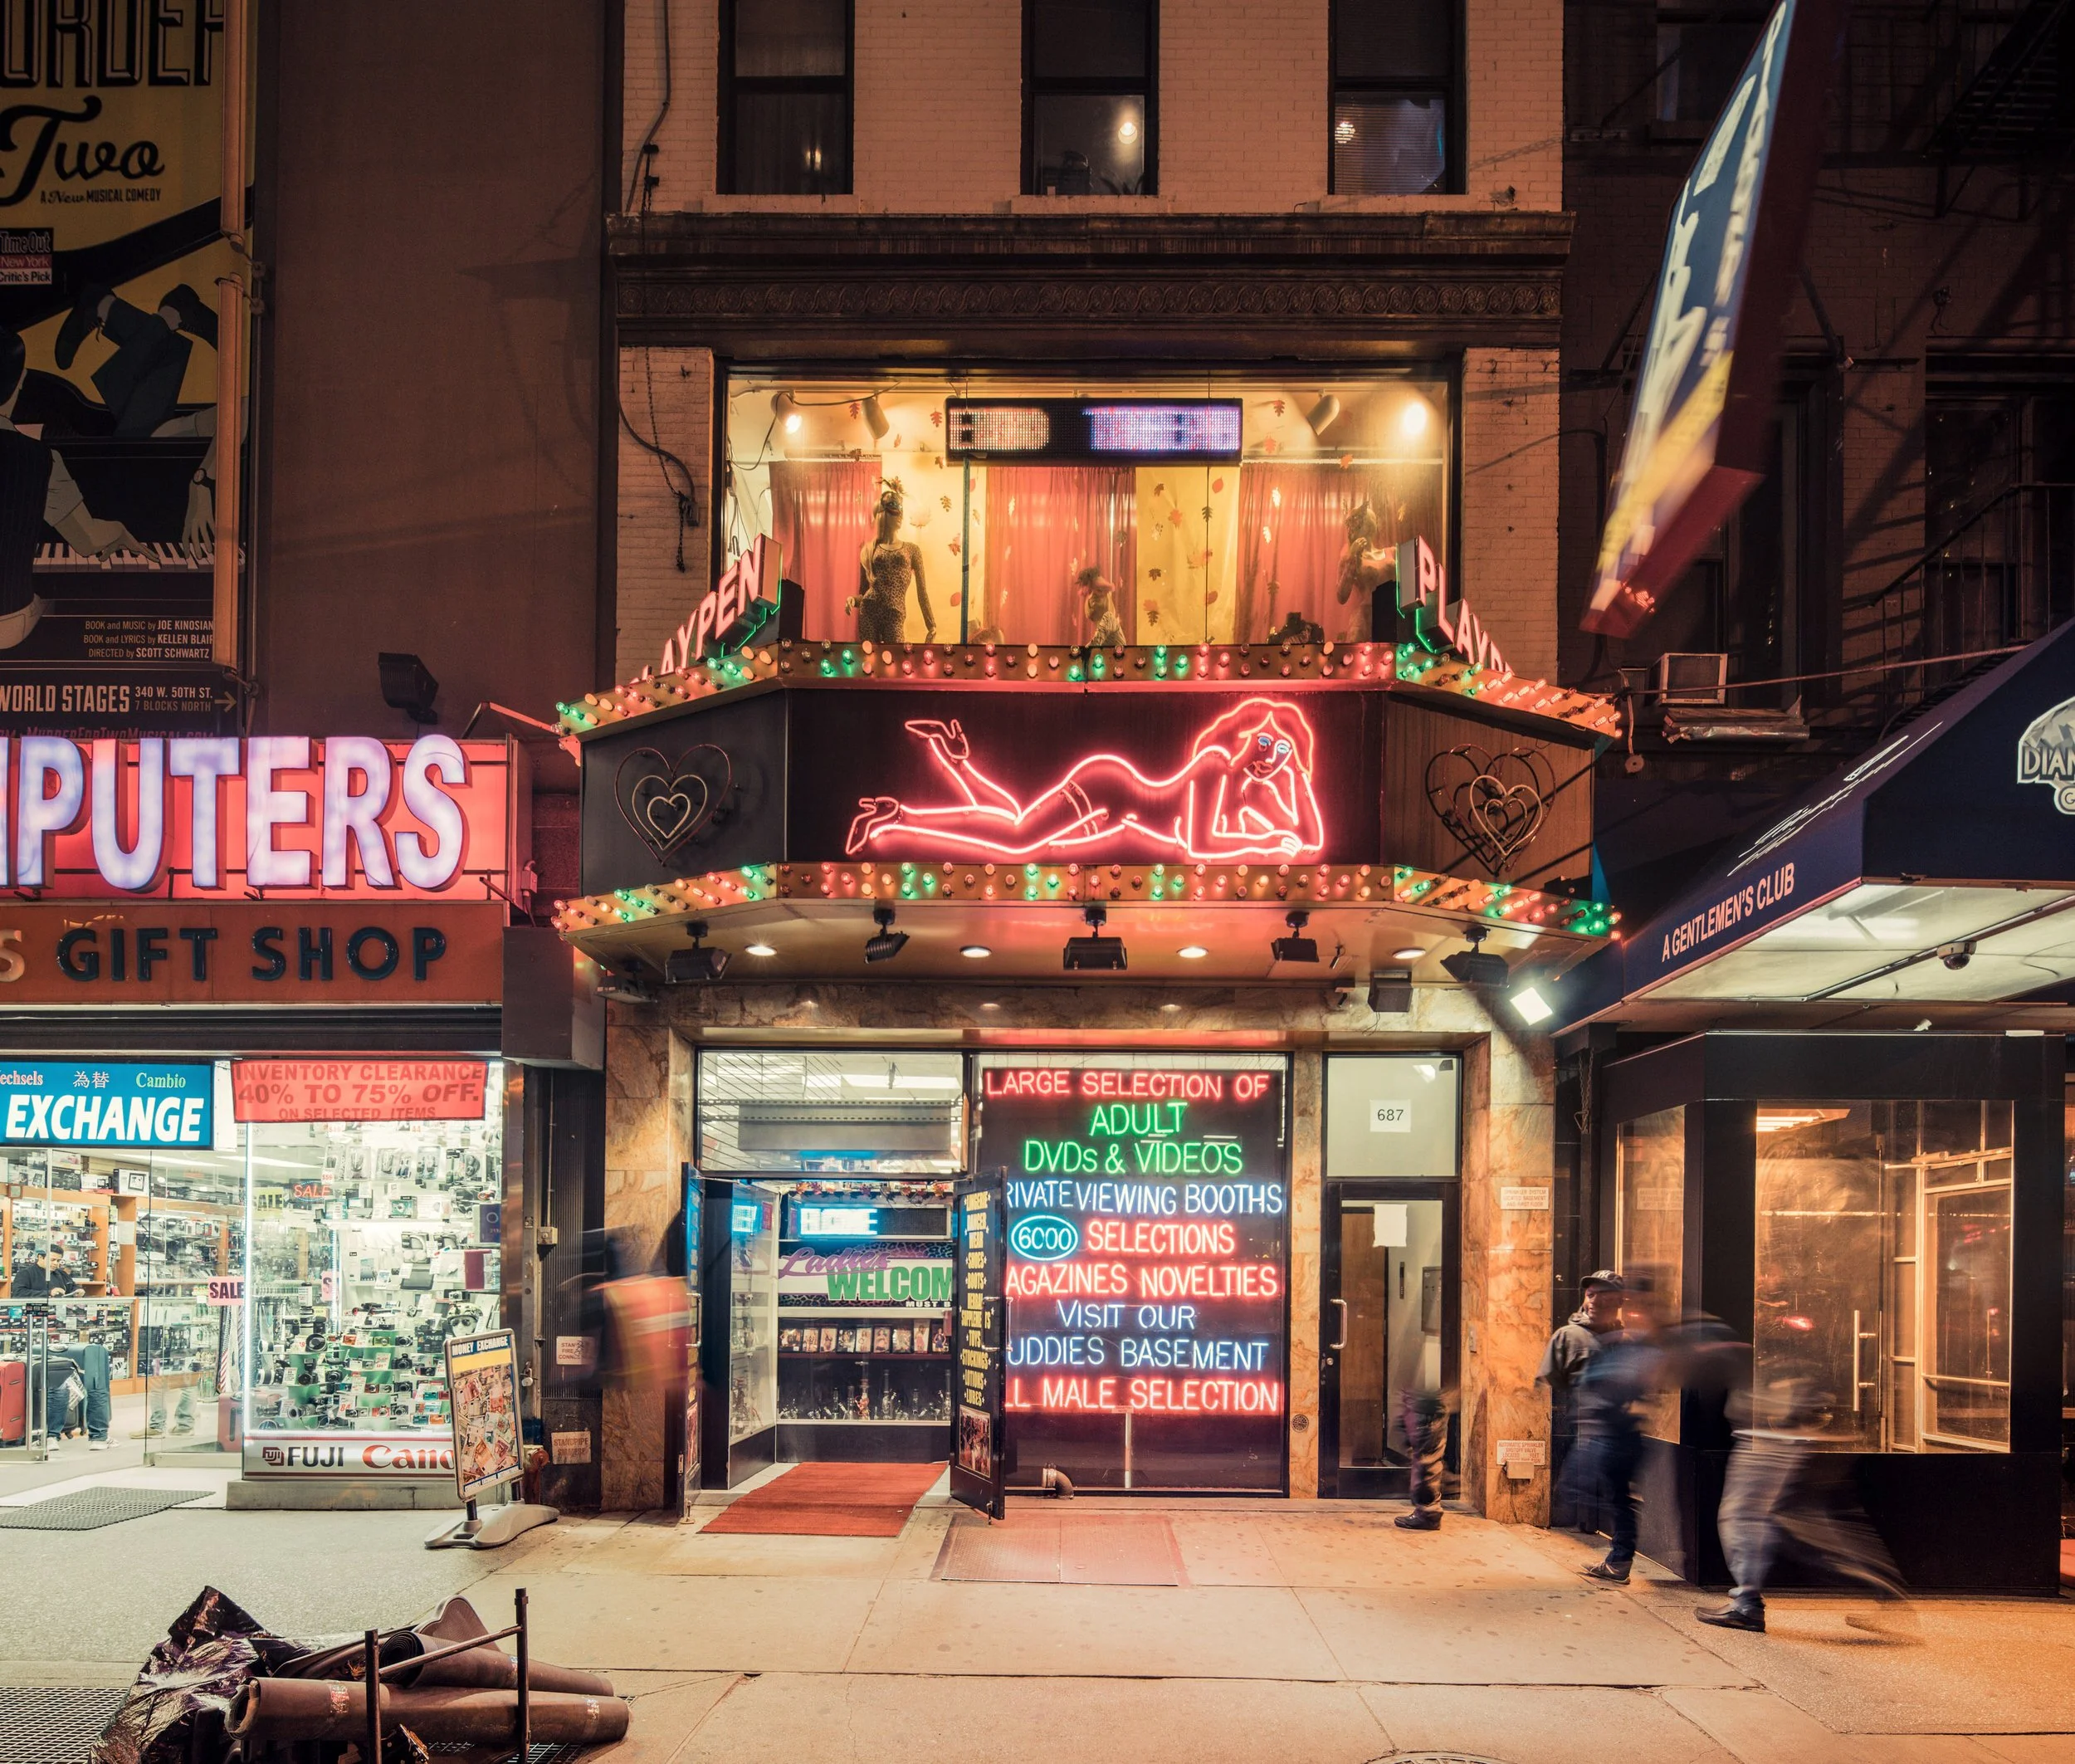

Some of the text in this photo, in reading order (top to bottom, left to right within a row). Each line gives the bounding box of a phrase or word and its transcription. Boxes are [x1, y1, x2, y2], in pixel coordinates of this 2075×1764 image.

[0, 95, 165, 207] Two
[41, 188, 161, 204] A New MUSICAL COMEDY
[1, 255, 49, 267] New York
[31, 271, 51, 282] Pick
[85, 620, 213, 633] BOOK and MUSIC by JOE KINOSIAN
[84, 635, 104, 644] BOOK
[105, 635, 119, 644] and
[121, 635, 145, 644] LYRICS
[148, 635, 156, 646] by
[158, 634, 188, 644] KELLEN
[89, 647, 209, 660] DIRECTED by SCOTT SCHWARTZ
[0, 685, 213, 712] WORLD STAGES 340 W. 50TH ST.
[135, 700, 211, 711] 7 BLOCKS NORTH
[0, 734, 470, 892] PUTERS
[1662, 862, 1795, 964] A GENTLEMEN'S CLUB
[56, 927, 217, 982] GIFT
[251, 927, 447, 982] SHOP
[0, 1070, 43, 1086] echsels
[135, 1073, 187, 1088] Cambio
[236, 1063, 482, 1081] INVENTORY CLEARANCE
[238, 1082, 479, 1104] 40% TO 75% OFF.
[986, 1070, 1270, 1098] LARGE SELECTION OF
[5, 1094, 205, 1142] EXCHANGE
[279, 1107, 437, 1120] ON SELECTED ITEMS
[1089, 1101, 1189, 1136] ADULT
[1377, 1108, 1404, 1121] 687
[1024, 1140, 1243, 1174] DVDs & VIDEOS
[293, 1183, 331, 1198] SALE
[1075, 1181, 1177, 1214] VIEWING
[1184, 1183, 1283, 1214] BOOTHS
[1018, 1220, 1235, 1255] 6000 SELECTIONS
[779, 1247, 891, 1278] Ladies
[209, 1282, 244, 1298] SALE
[1005, 1263, 1278, 1297] AGAZINES NOVELTIES
[961, 1309, 991, 1329] SUPPLEMETS
[1056, 1298, 1196, 1329] VISIT OUR
[452, 1335, 509, 1356] MONEY EXCHANGE
[969, 1330, 981, 1347] TOYS
[1008, 1335, 1269, 1371] UDDIES BASEMENT
[966, 1388, 982, 1407] LUBES
[1042, 1377, 1116, 1410] MALE
[1130, 1379, 1279, 1412] SELECTION
[554, 1437, 589, 1447] STANDPIPE
[287, 1446, 344, 1468] FUJI
